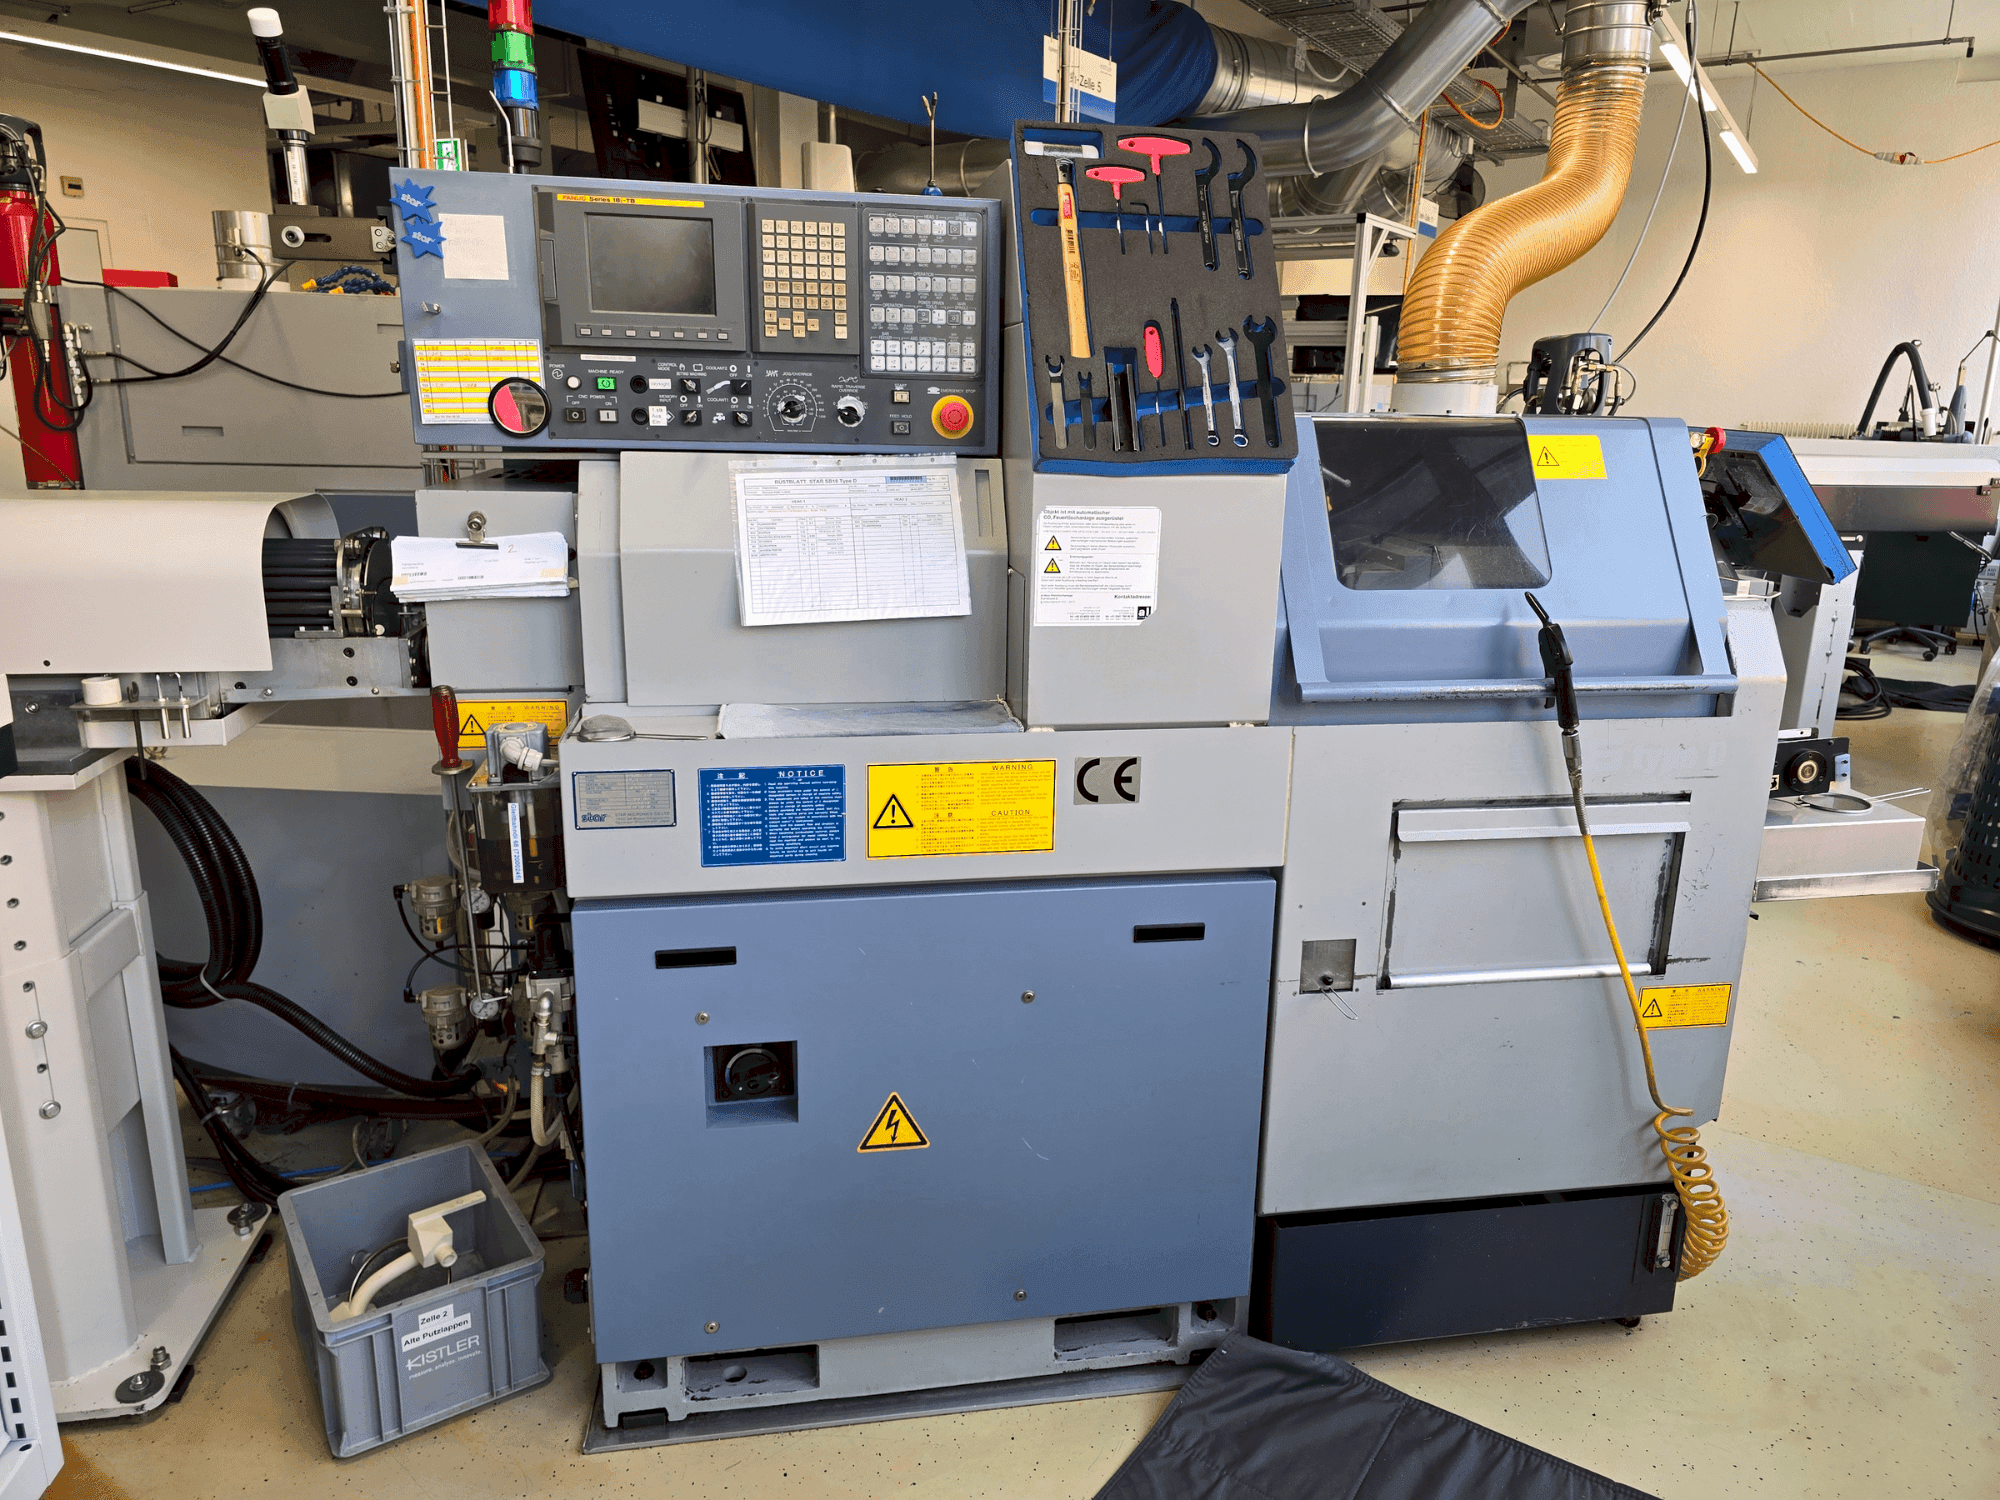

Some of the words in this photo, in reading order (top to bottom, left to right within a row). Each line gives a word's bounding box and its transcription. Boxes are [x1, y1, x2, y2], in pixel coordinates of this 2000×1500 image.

[1097, 81, 1102, 93] 5
[401, 193, 425, 207] star
[589, 195, 611, 203] Series
[412, 231, 436, 244] star
[508, 544, 517, 554] 2
[1076, 757, 1138, 803] CE
[581, 812, 607, 822] star
[420, 1314, 440, 1325] Zelle
[404, 1336, 420, 1346] Alte
[422, 1320, 469, 1339] Putzlappen
[406, 1335, 480, 1371] KISTLER
[409, 1368, 434, 1380] measure.
[435, 1359, 457, 1370] analyze.
[458, 1350, 482, 1361] innovate.
